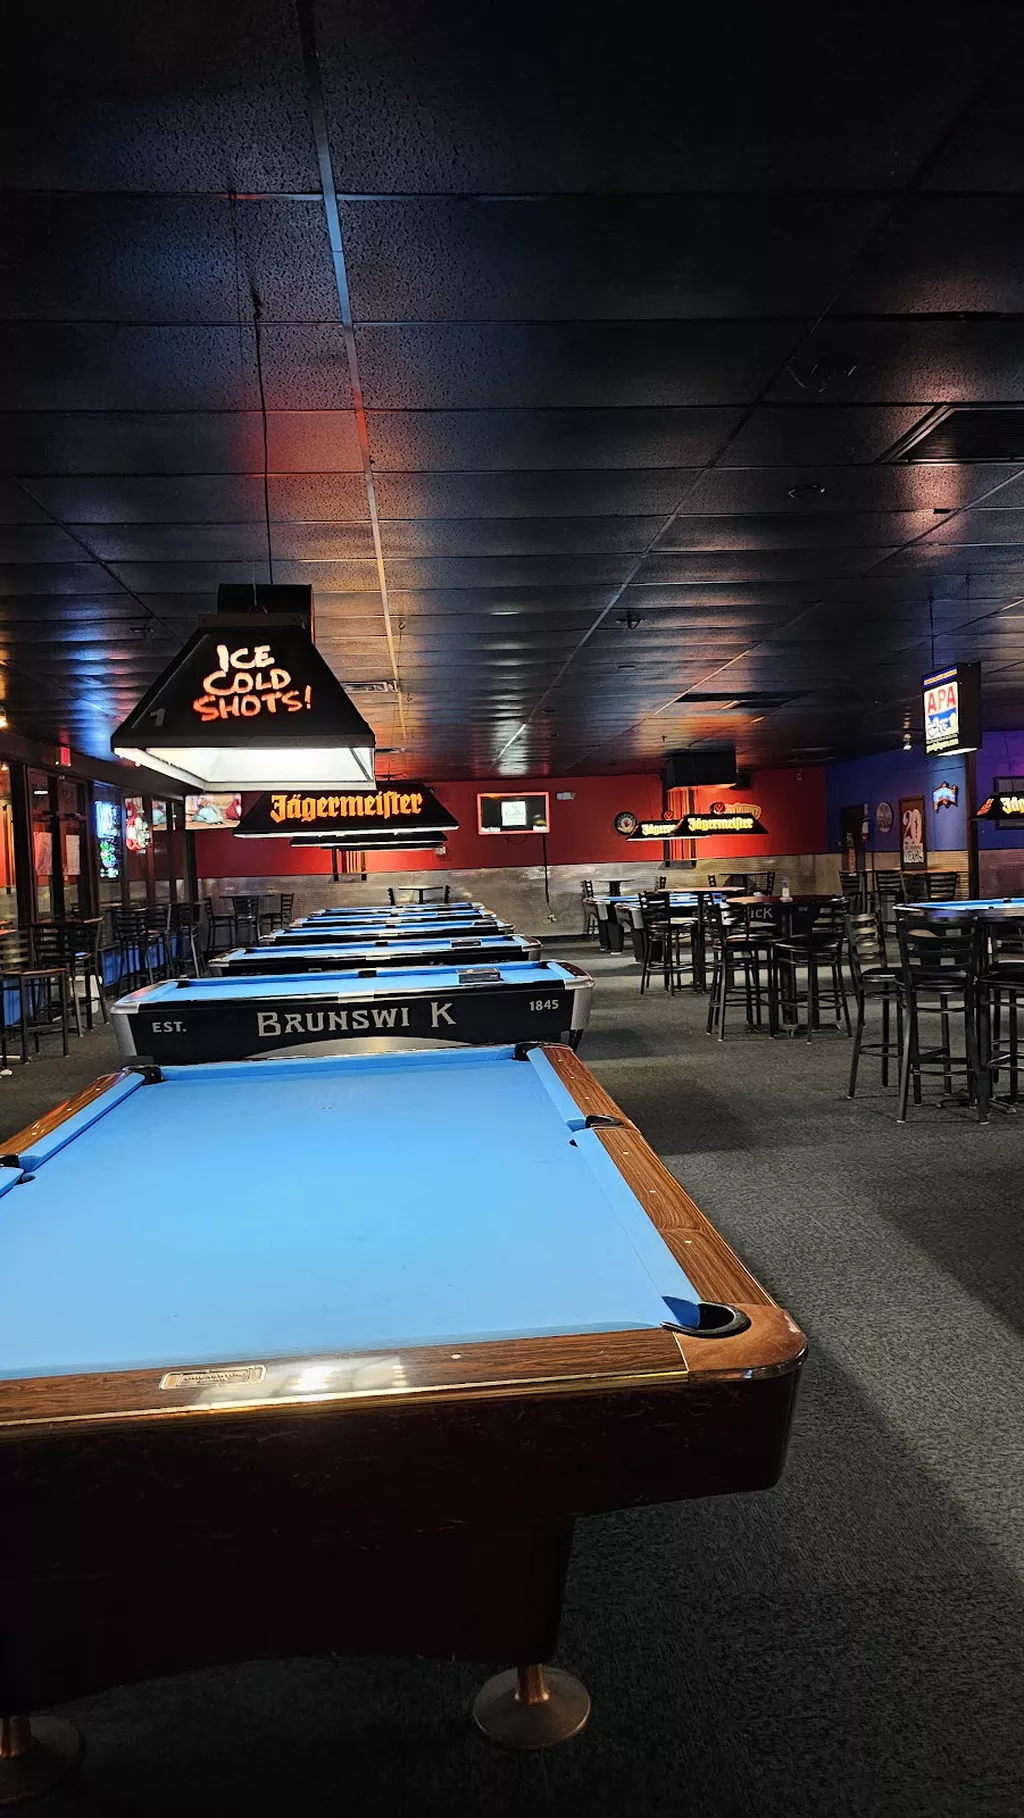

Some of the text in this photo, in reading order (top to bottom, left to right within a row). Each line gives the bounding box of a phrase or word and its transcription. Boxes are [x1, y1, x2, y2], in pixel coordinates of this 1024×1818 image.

[216, 644, 275, 673] ICE
[202, 667, 292, 697] COLD
[192, 684, 312, 723] SHOTS!
[927, 683, 956, 715] APA
[152, 1020, 187, 1034] EST.
[528, 998, 559, 1013] 1845
